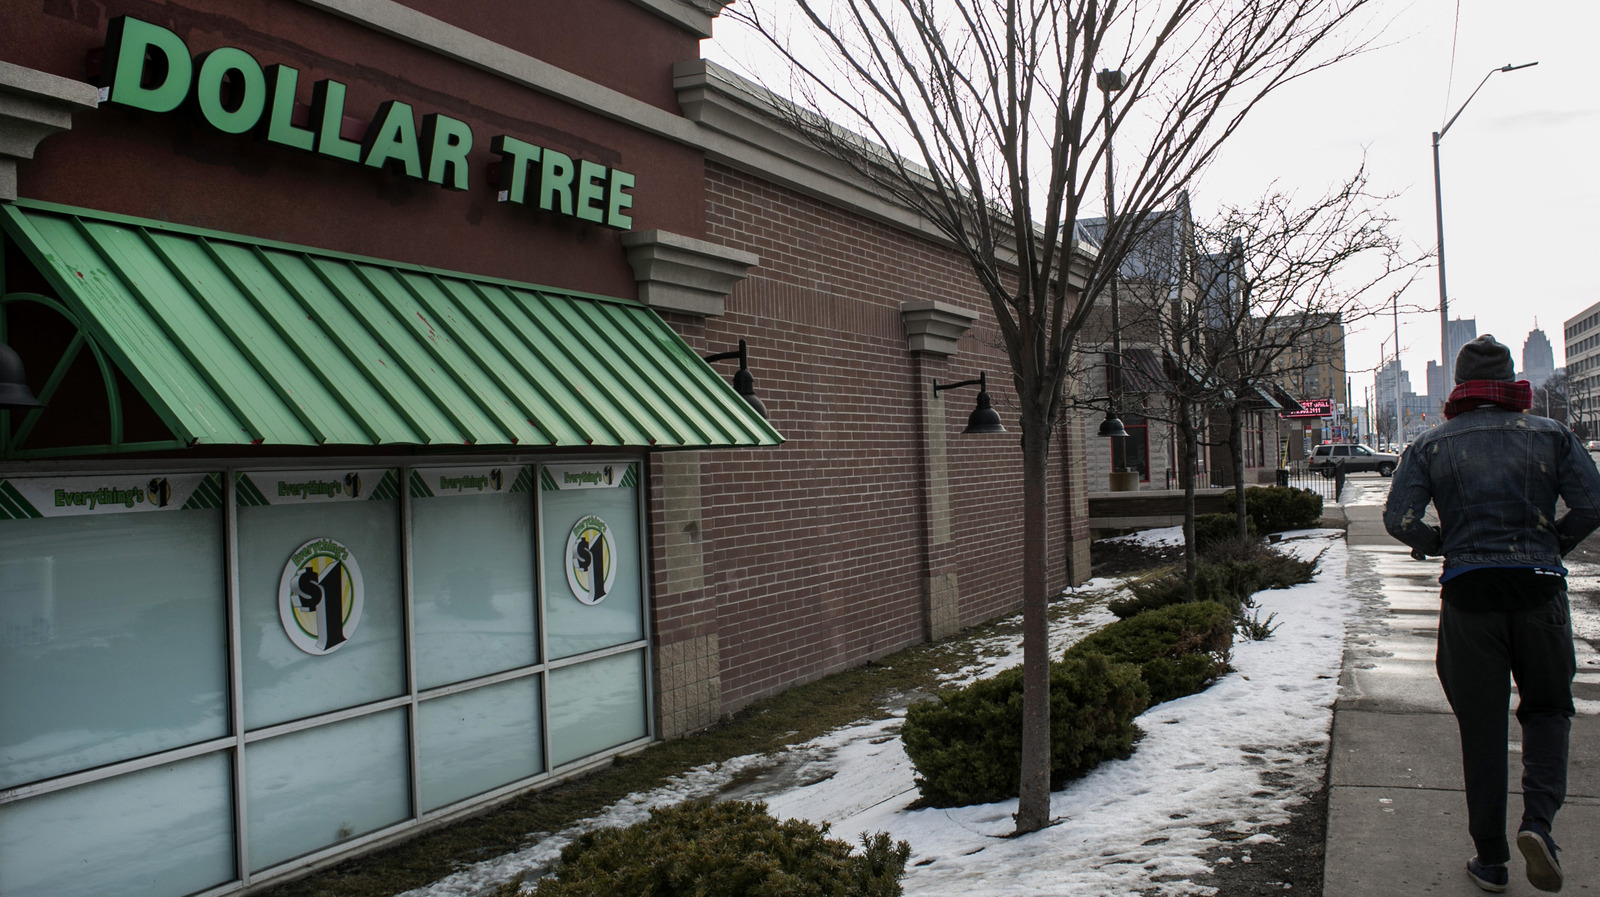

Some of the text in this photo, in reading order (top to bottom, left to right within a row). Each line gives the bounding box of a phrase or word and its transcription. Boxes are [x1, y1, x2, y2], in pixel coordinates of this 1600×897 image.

[108, 14, 636, 230] DOLLAR TREE
[278, 472, 360, 499] Everything's $1
[440, 468, 502, 492] Everything's $1
[564, 471, 602, 486] Everything's
[54, 477, 168, 510] Everything's $1
[573, 516, 607, 537] Everything's
[292, 538, 349, 567] Everything's
[572, 532, 607, 602] $1
[290, 559, 348, 651] $1
